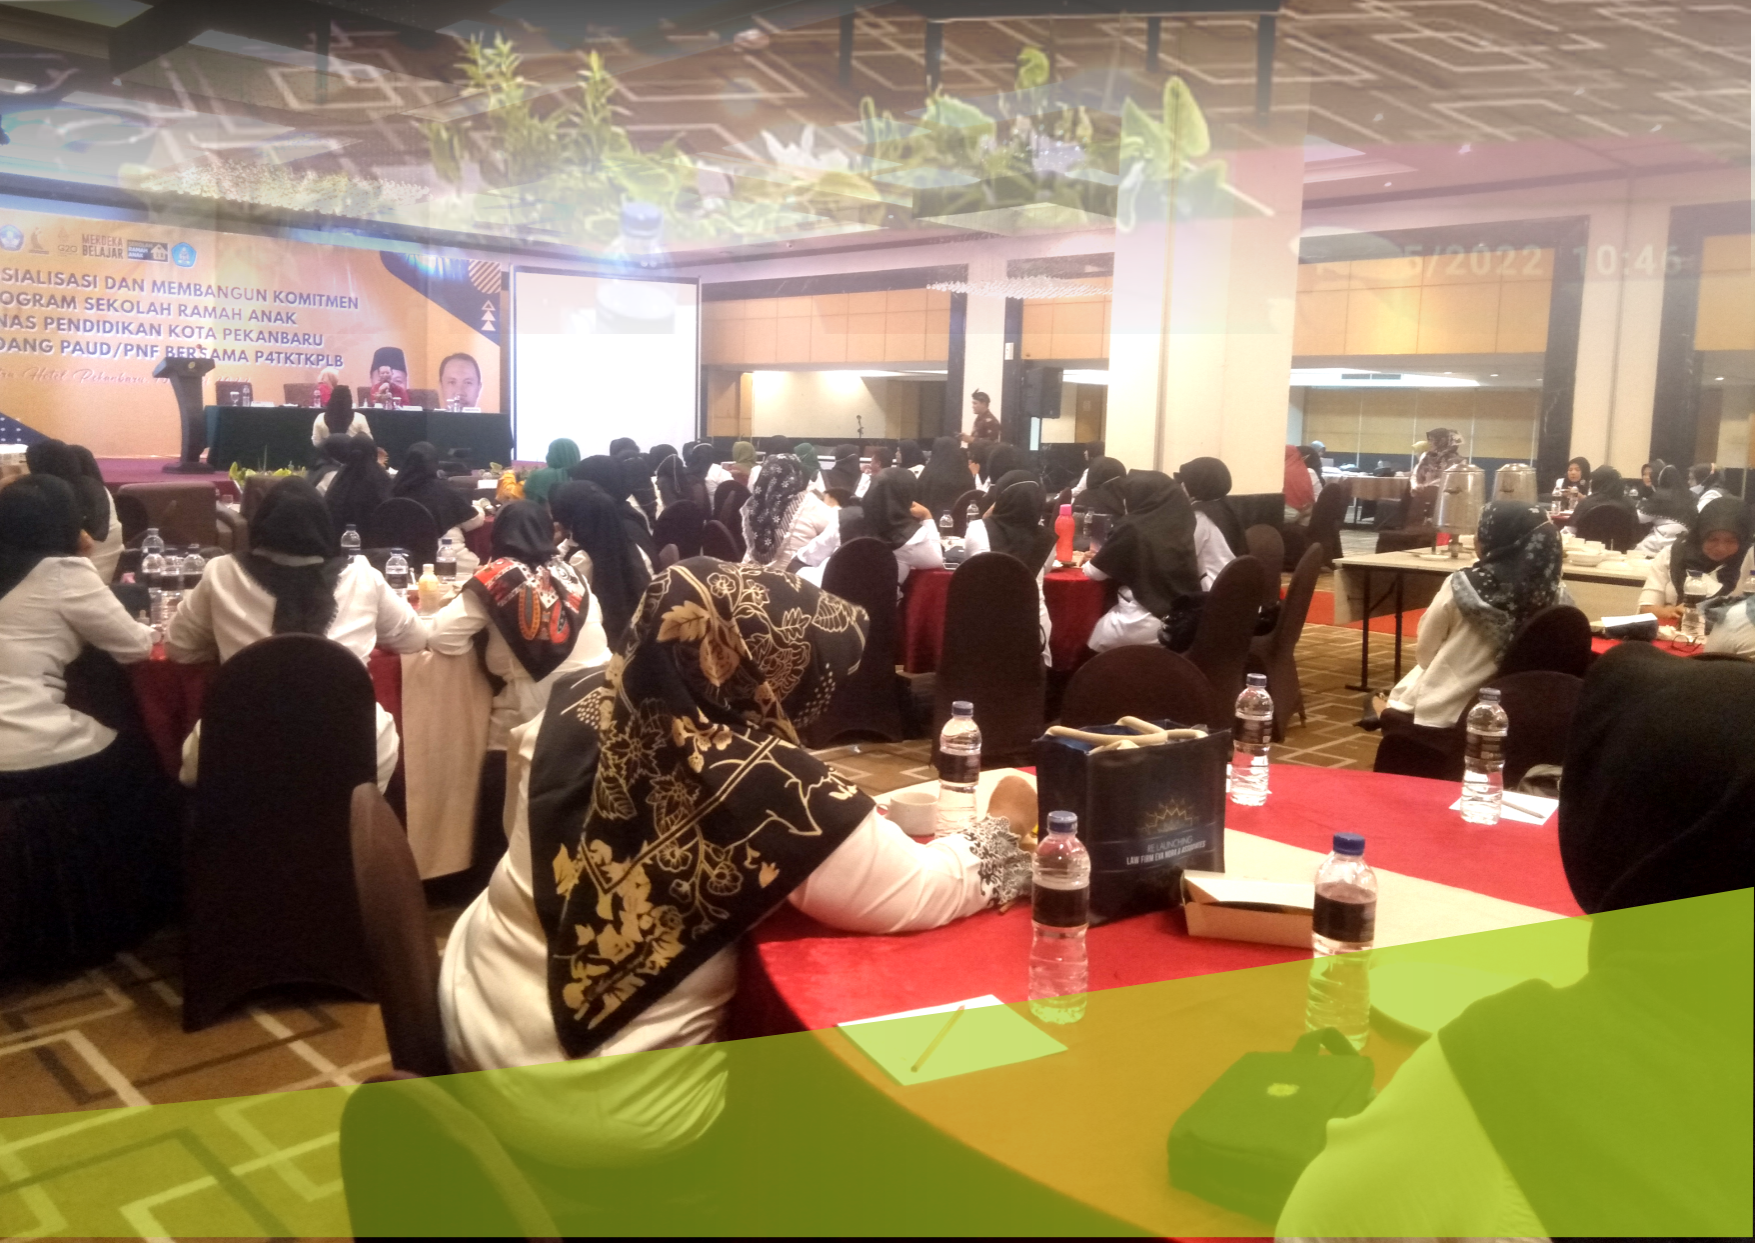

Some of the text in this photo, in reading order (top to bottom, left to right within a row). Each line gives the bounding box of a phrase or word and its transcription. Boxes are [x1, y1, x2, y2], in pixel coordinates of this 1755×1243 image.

[57, 244, 78, 254] G20
[82, 233, 124, 248] MERDEKA
[82, 245, 124, 260] BELAJAR
[105, 276, 145, 293] DAN
[151, 280, 268, 303] MEMBANGUN
[273, 290, 359, 310] KOMITMEN
[84, 296, 172, 317] SEKOLAH
[178, 304, 242, 321] RAMAH
[248, 309, 297, 325] ANAK
[44, 316, 162, 338] PENDIDIKAN
[168, 324, 217, 341] KOTA
[223, 328, 324, 347] PEKANBARU
[61, 339, 159, 359] PAUD/PNF
[165, 345, 250, 363] BERSAMA
[255, 350, 344, 368] P4TKTKPLB
[1156, 835, 1194, 852] LAUNCHING
[1126, 855, 1140, 866] LAW
[1140, 853, 1155, 864] FIRM
